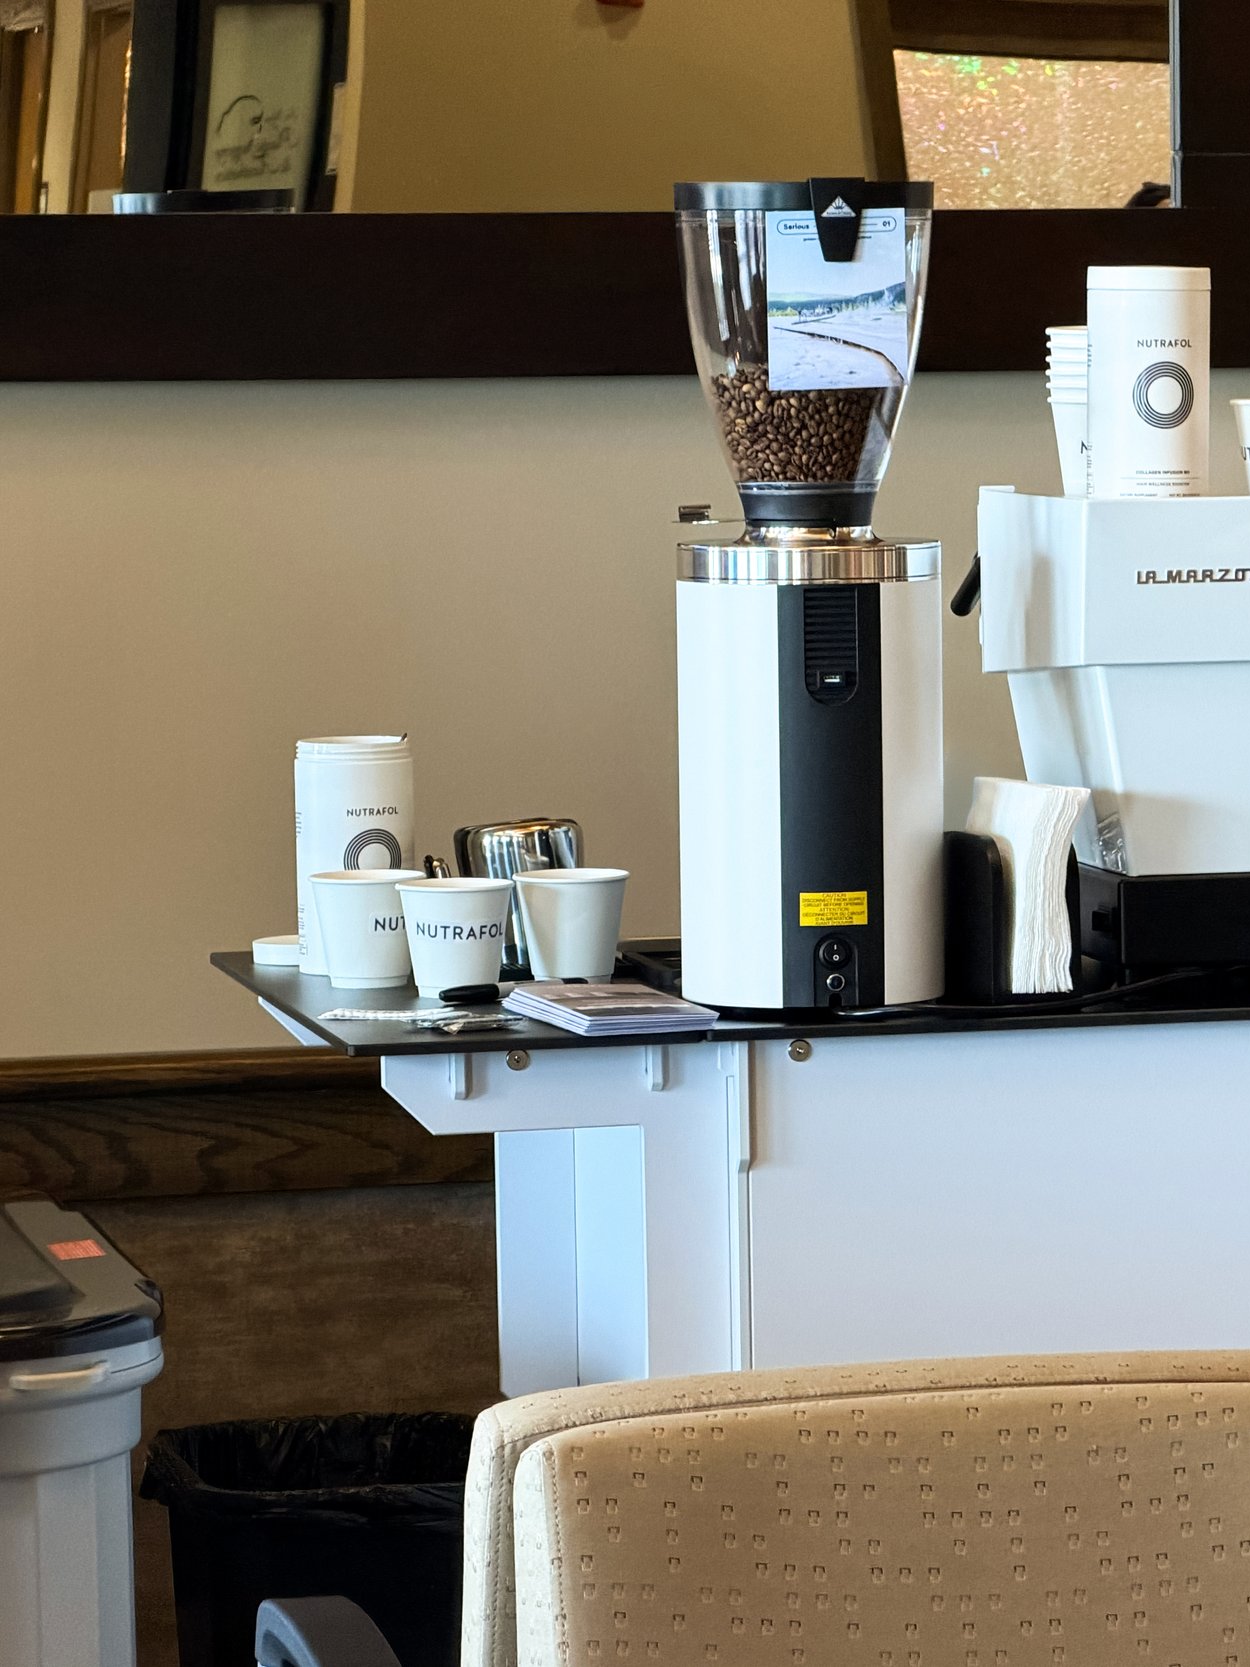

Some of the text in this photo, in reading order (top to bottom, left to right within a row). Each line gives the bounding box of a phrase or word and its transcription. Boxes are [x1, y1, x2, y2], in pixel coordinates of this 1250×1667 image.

[783, 223, 810, 231] Serious
[1137, 339, 1192, 349] NUTRAFOL
[1137, 570, 1157, 584] LA
[347, 806, 398, 817] NUTRAFOL
[416, 922, 503, 940] NUTRAFOL
